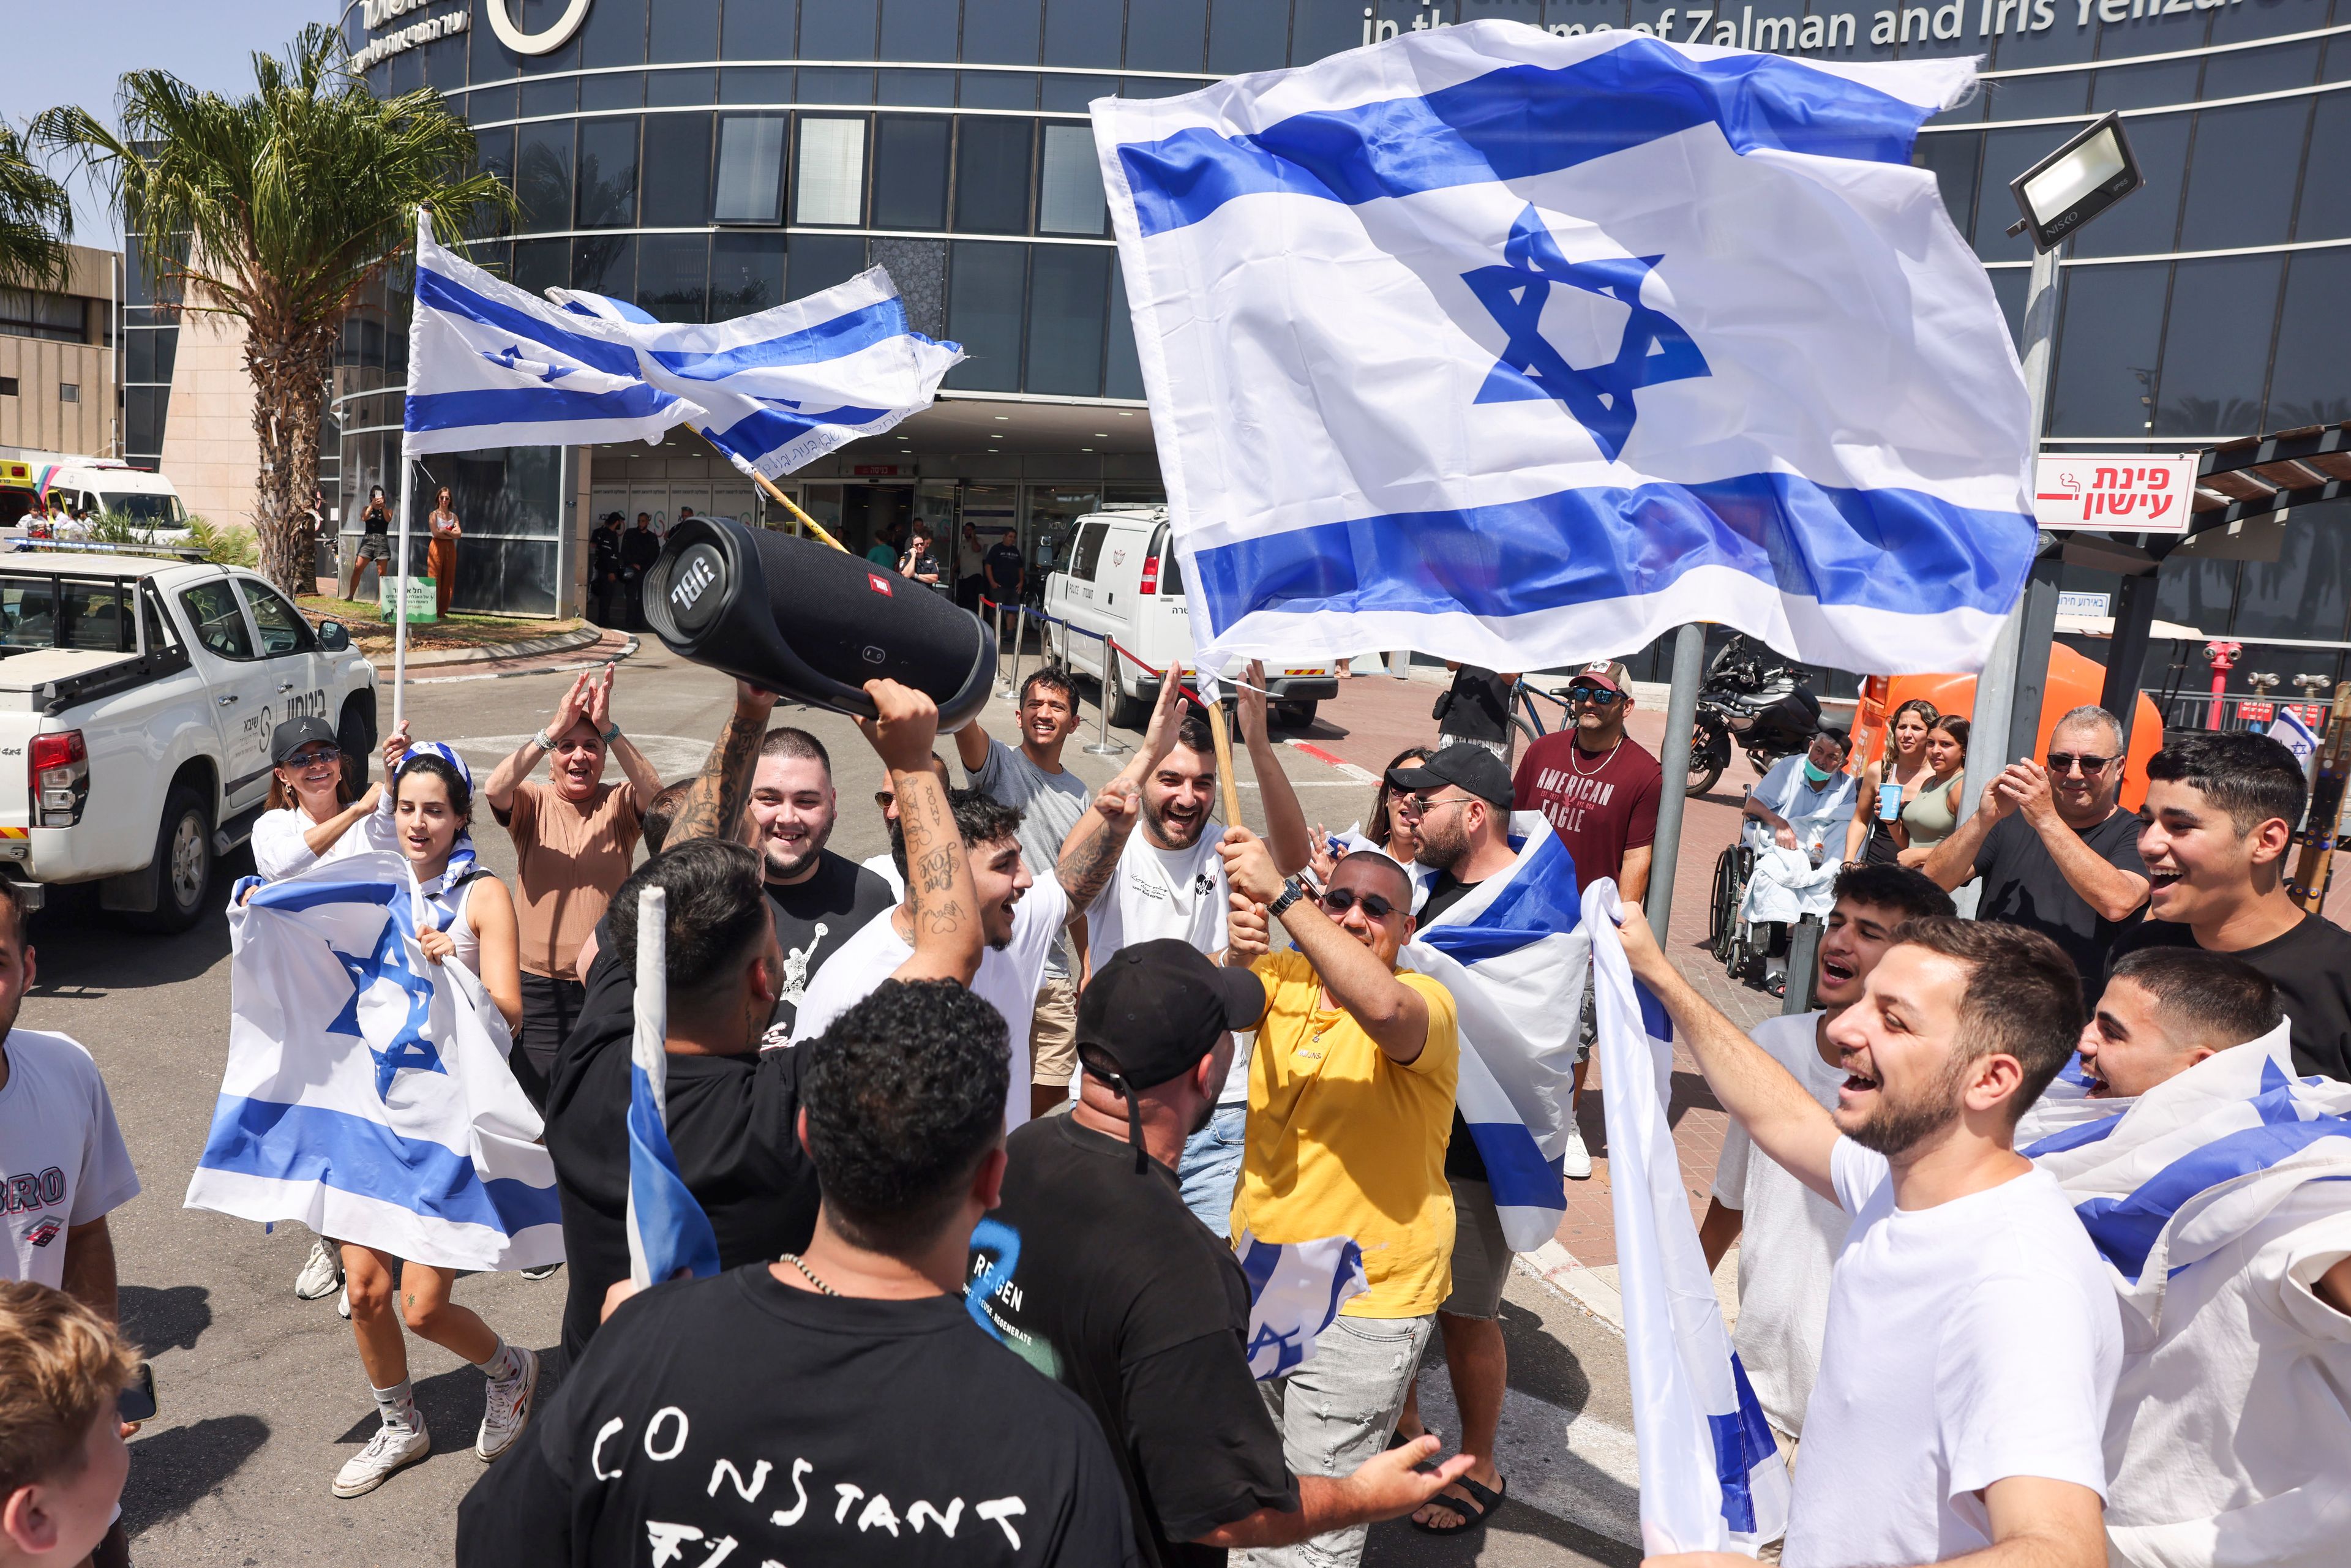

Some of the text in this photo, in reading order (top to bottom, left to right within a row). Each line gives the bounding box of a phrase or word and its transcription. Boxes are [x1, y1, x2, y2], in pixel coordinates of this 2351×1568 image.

[440, 10, 468, 34] עיר
[1362, 7, 1399, 47] in
[1685, 6, 1856, 51] Zalman
[1870, 0, 1964, 45] and
[1979, 0, 2055, 36] Iris
[2093, 468, 2170, 490] פינת
[2083, 493, 2173, 520] עישון
[671, 557, 715, 610] JBL
[1069, 583, 1079, 595] POLICE
[2077, 598, 2104, 607] באירוע
[244, 716, 258, 732] שיבא
[1536, 767, 1615, 806] AMERICAN
[1542, 798, 1586, 833] EAGLE
[592, 1406, 1027, 1551] CONSTANT
